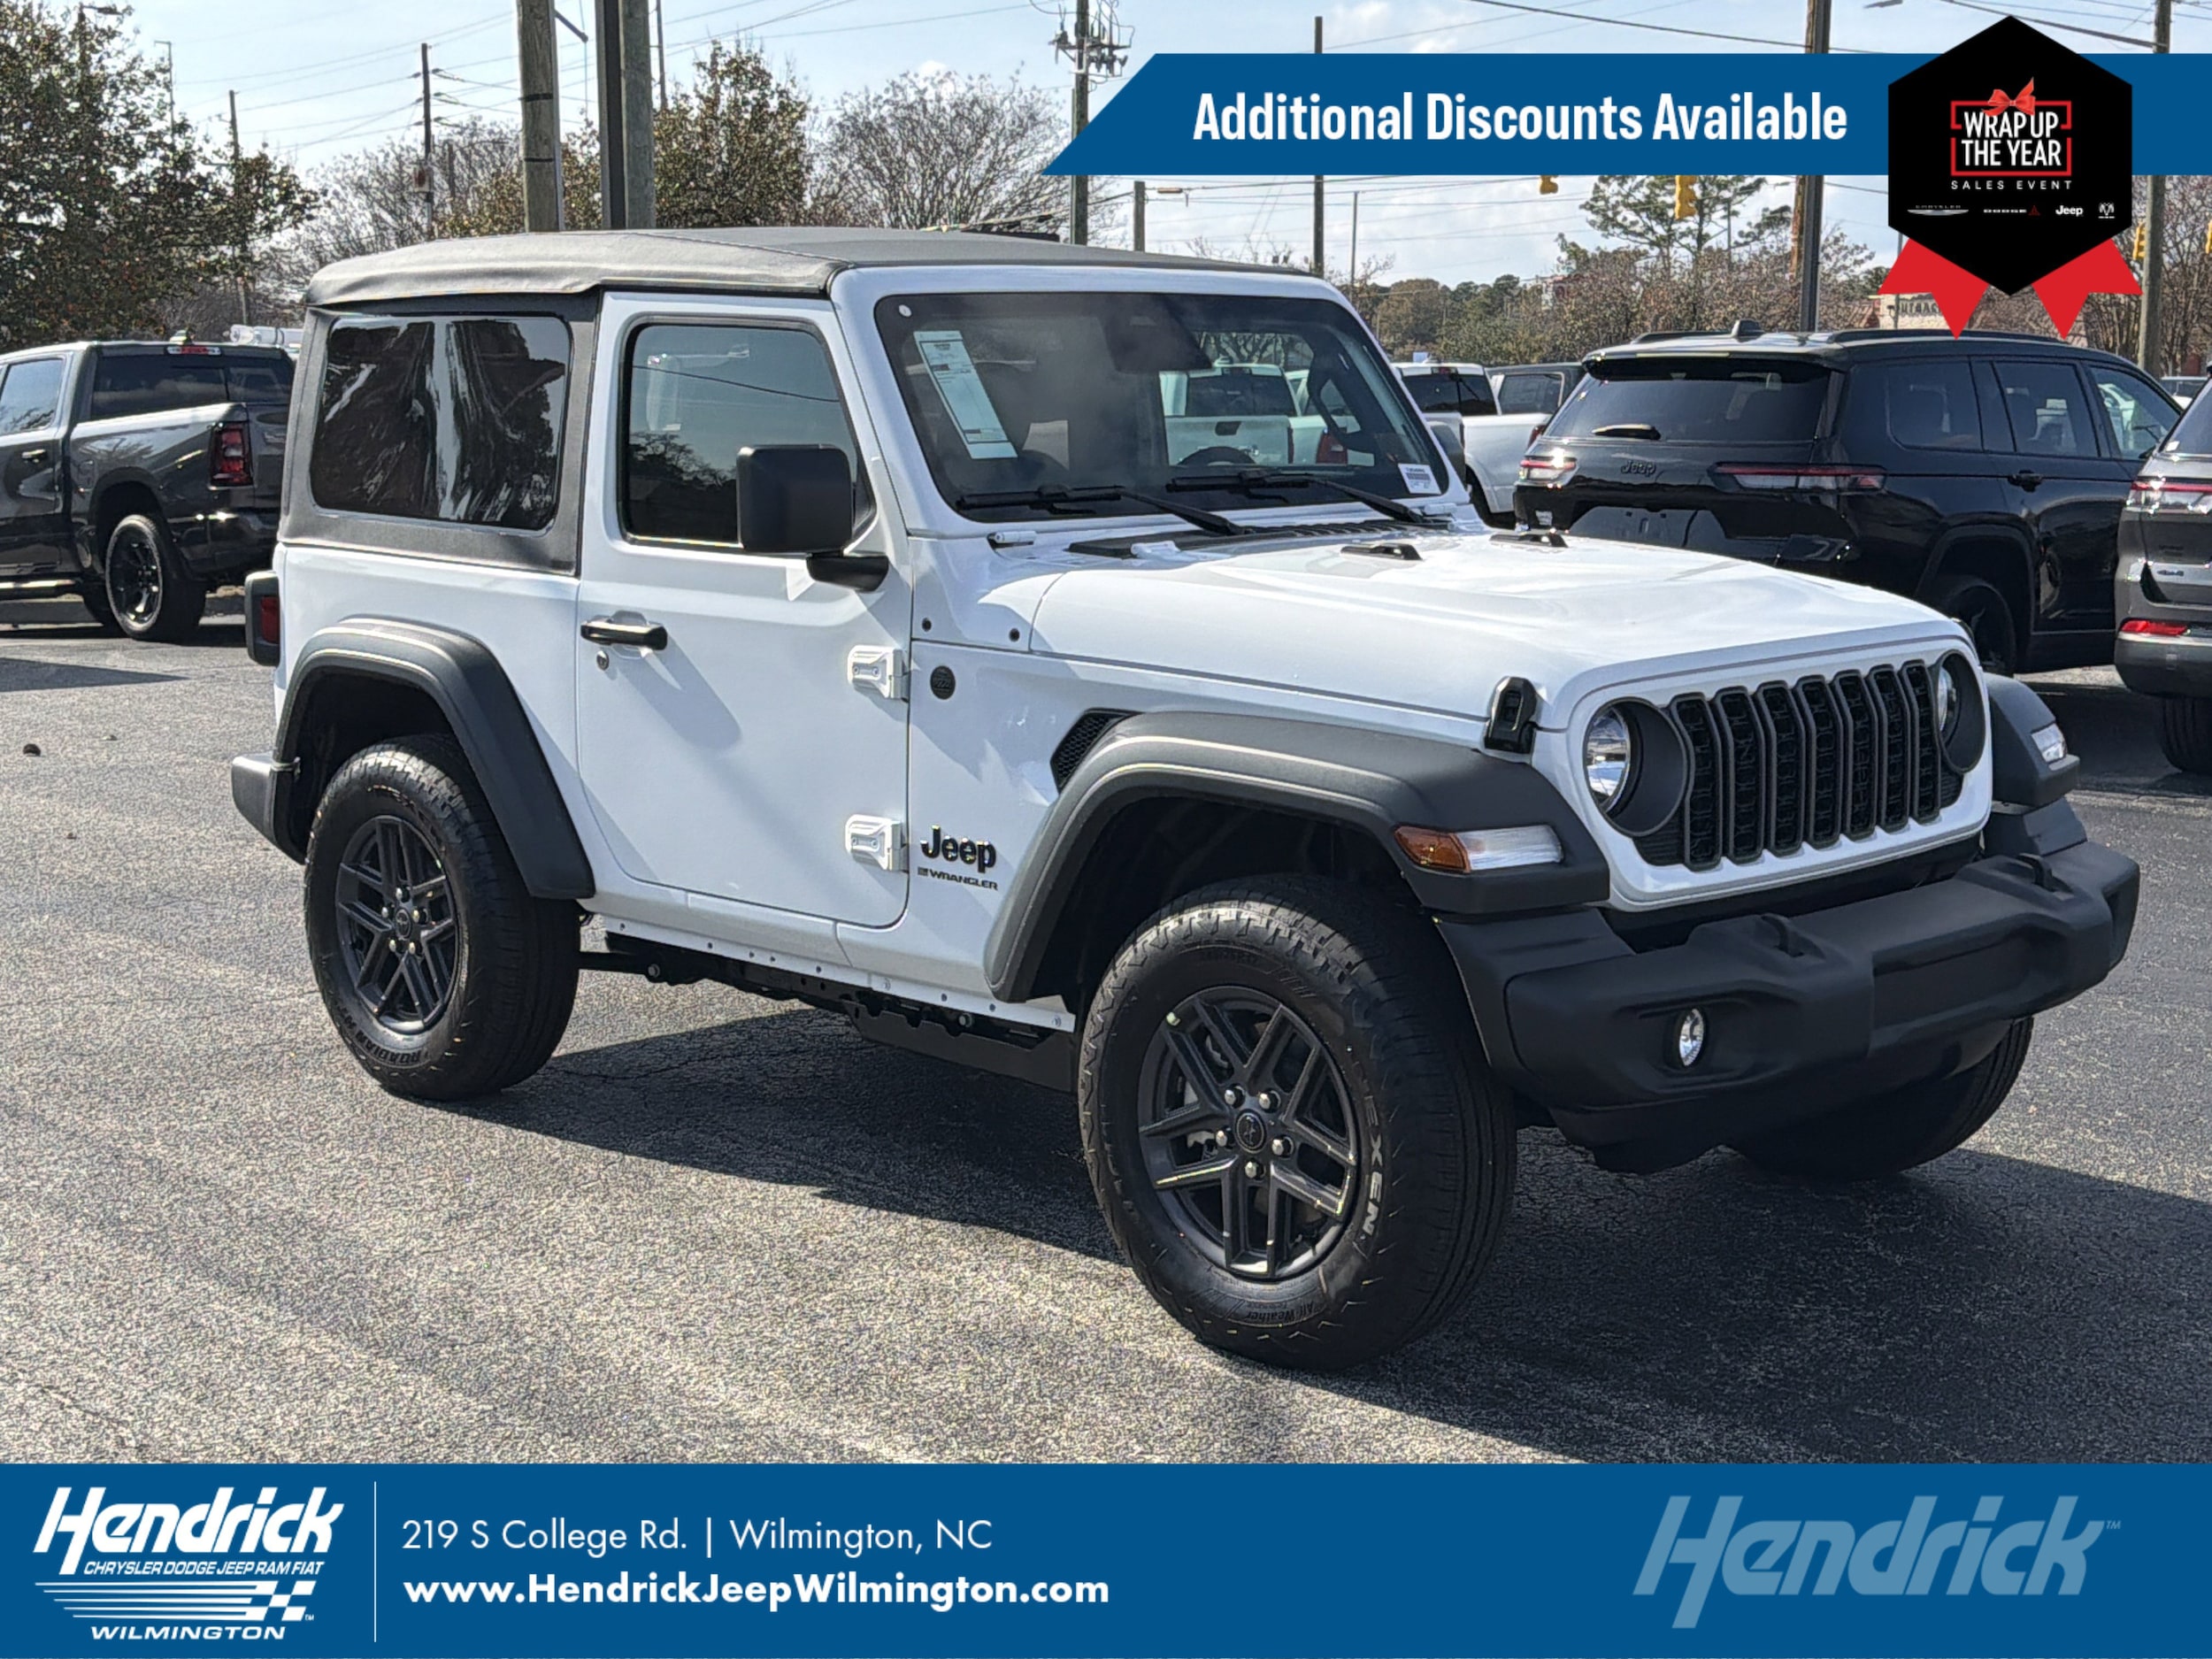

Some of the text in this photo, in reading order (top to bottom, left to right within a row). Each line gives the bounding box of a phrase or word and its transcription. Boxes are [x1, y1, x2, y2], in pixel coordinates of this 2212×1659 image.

[1620, 459, 1656, 478] Jeep
[920, 825, 996, 873] Jeep
[929, 868, 998, 890] WRANGLER
